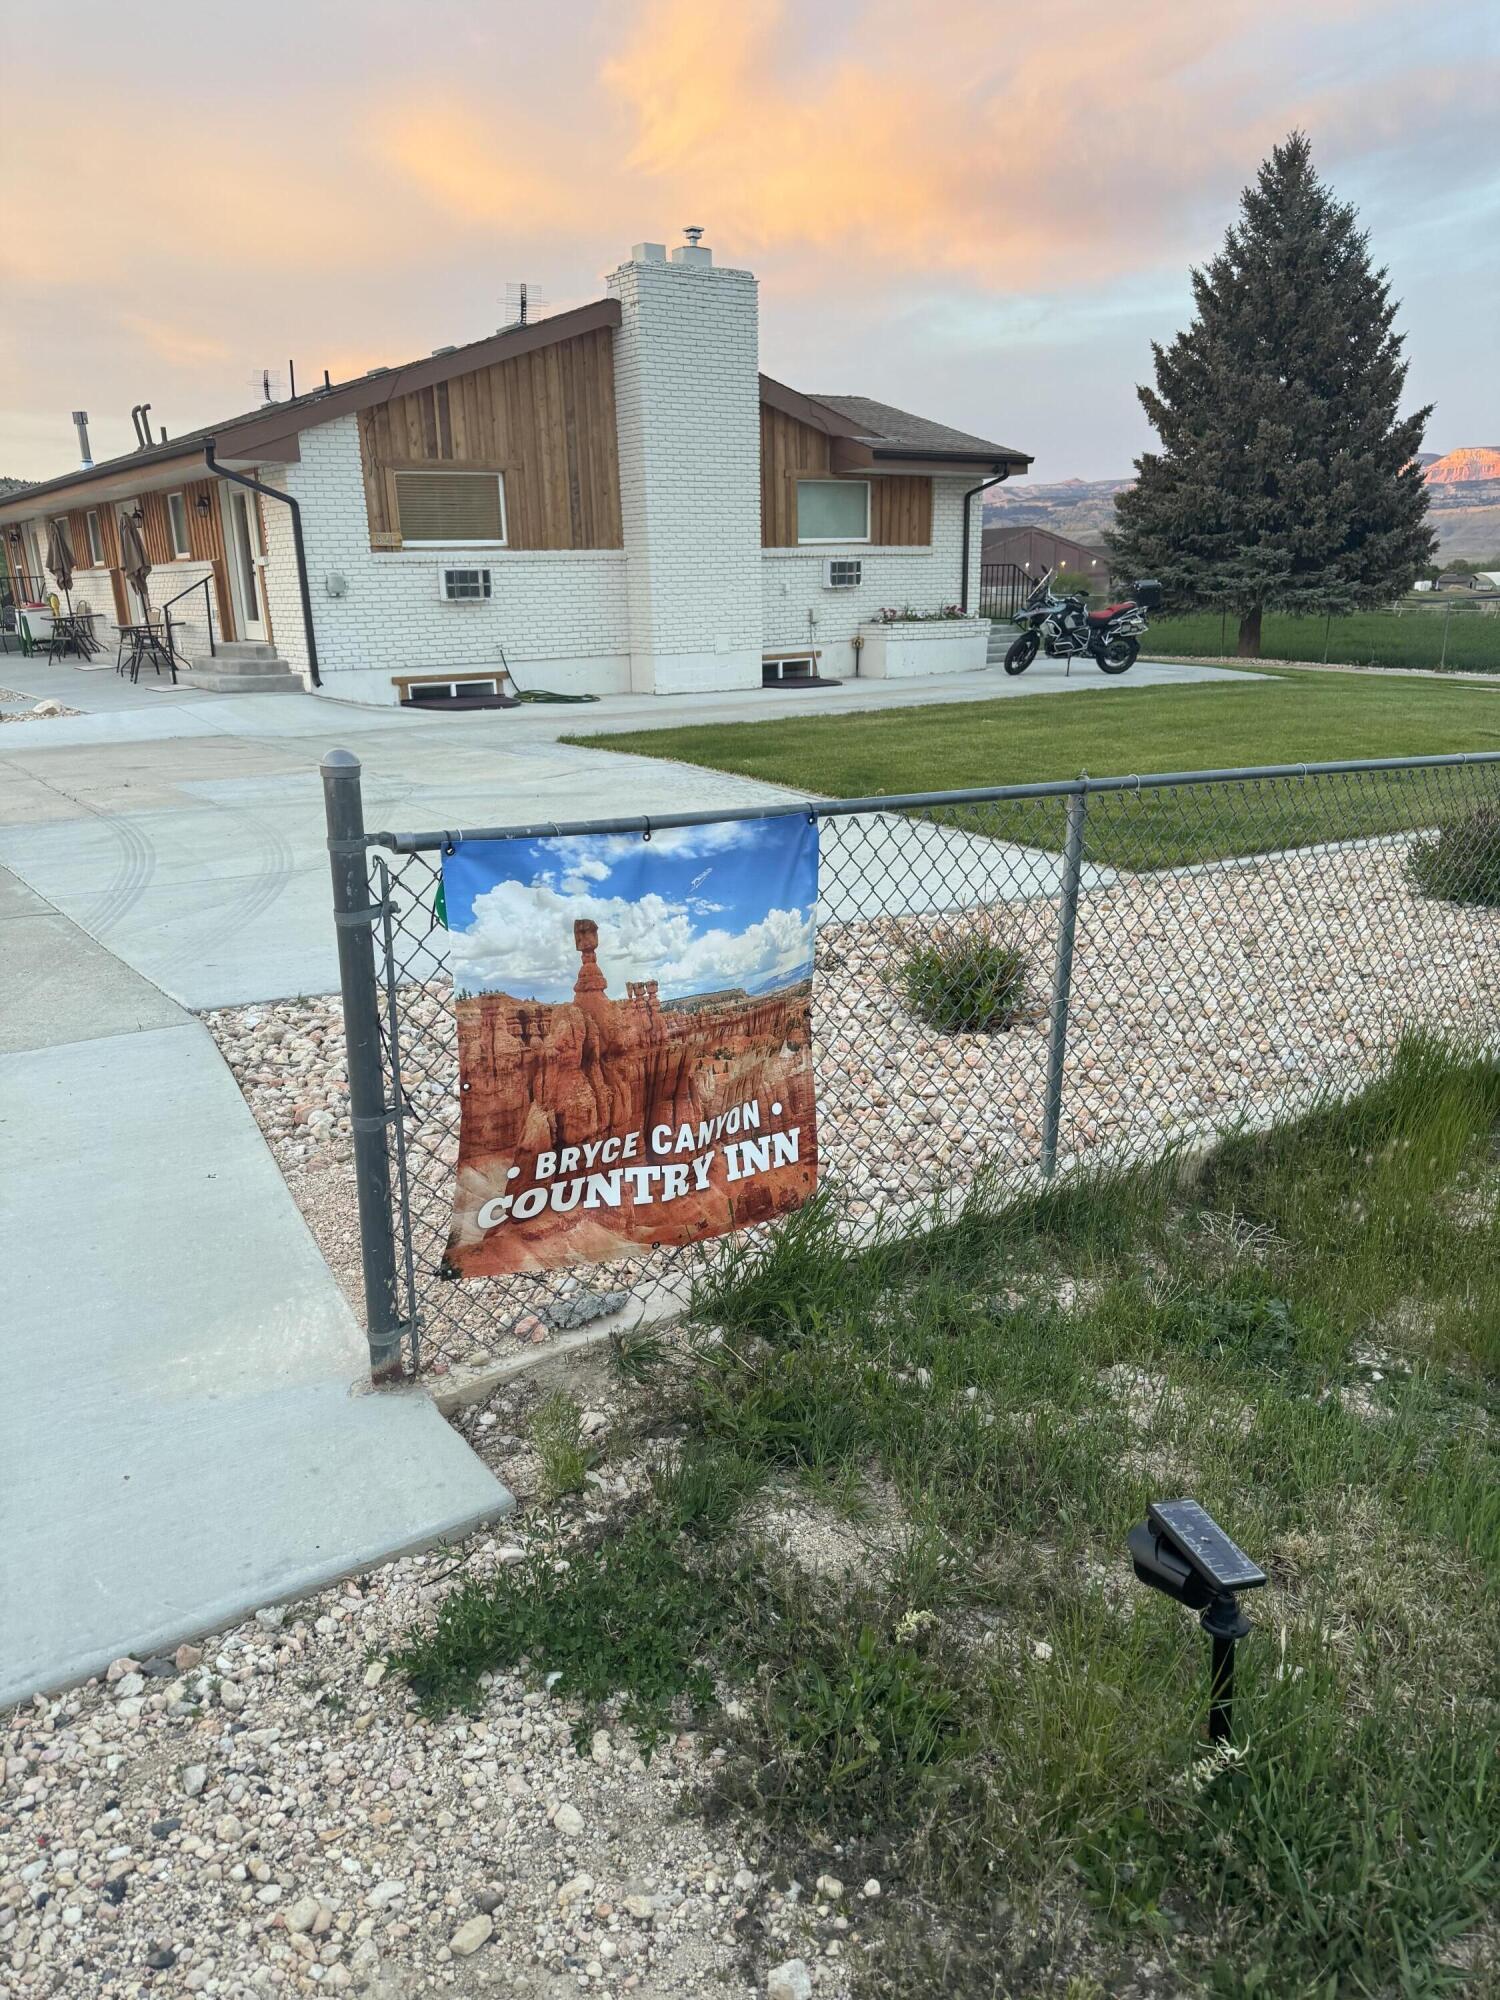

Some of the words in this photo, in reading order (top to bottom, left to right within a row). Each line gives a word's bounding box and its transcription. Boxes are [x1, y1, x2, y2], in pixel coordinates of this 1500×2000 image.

[477, 1152, 714, 1229] COUNTRY
[724, 1128, 801, 1182] INN
[535, 1131, 640, 1180] BRYCE
[651, 1100, 760, 1156] CANYON
